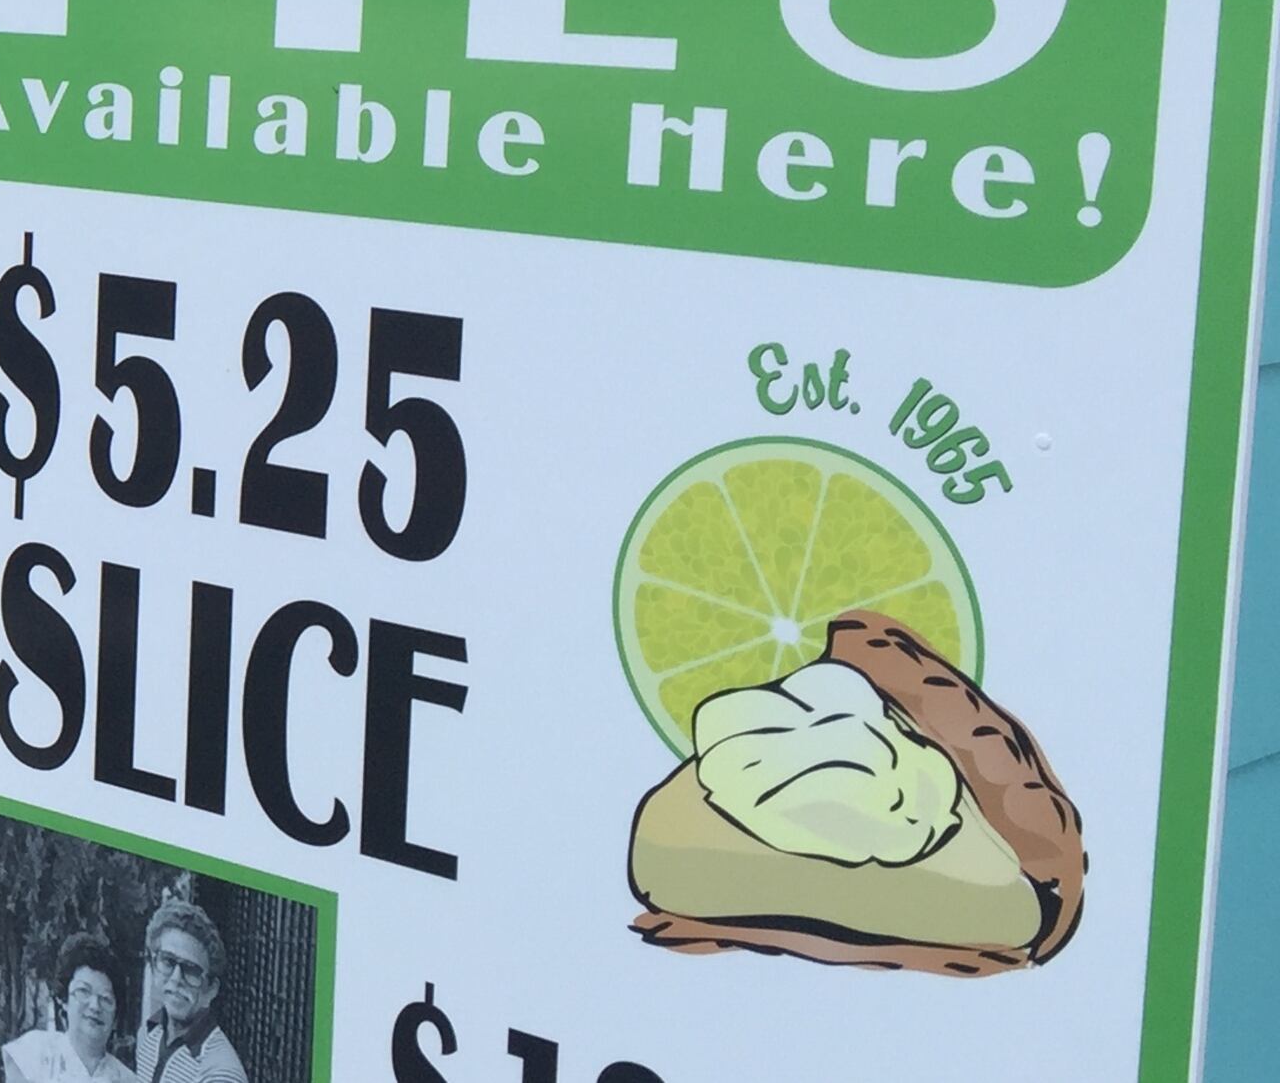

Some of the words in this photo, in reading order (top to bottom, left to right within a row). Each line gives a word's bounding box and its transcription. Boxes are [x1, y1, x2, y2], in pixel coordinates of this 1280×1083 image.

[626, 102, 1112, 228] Here!
[747, 342, 861, 416] Est.
[888, 377, 1014, 505] 1965
